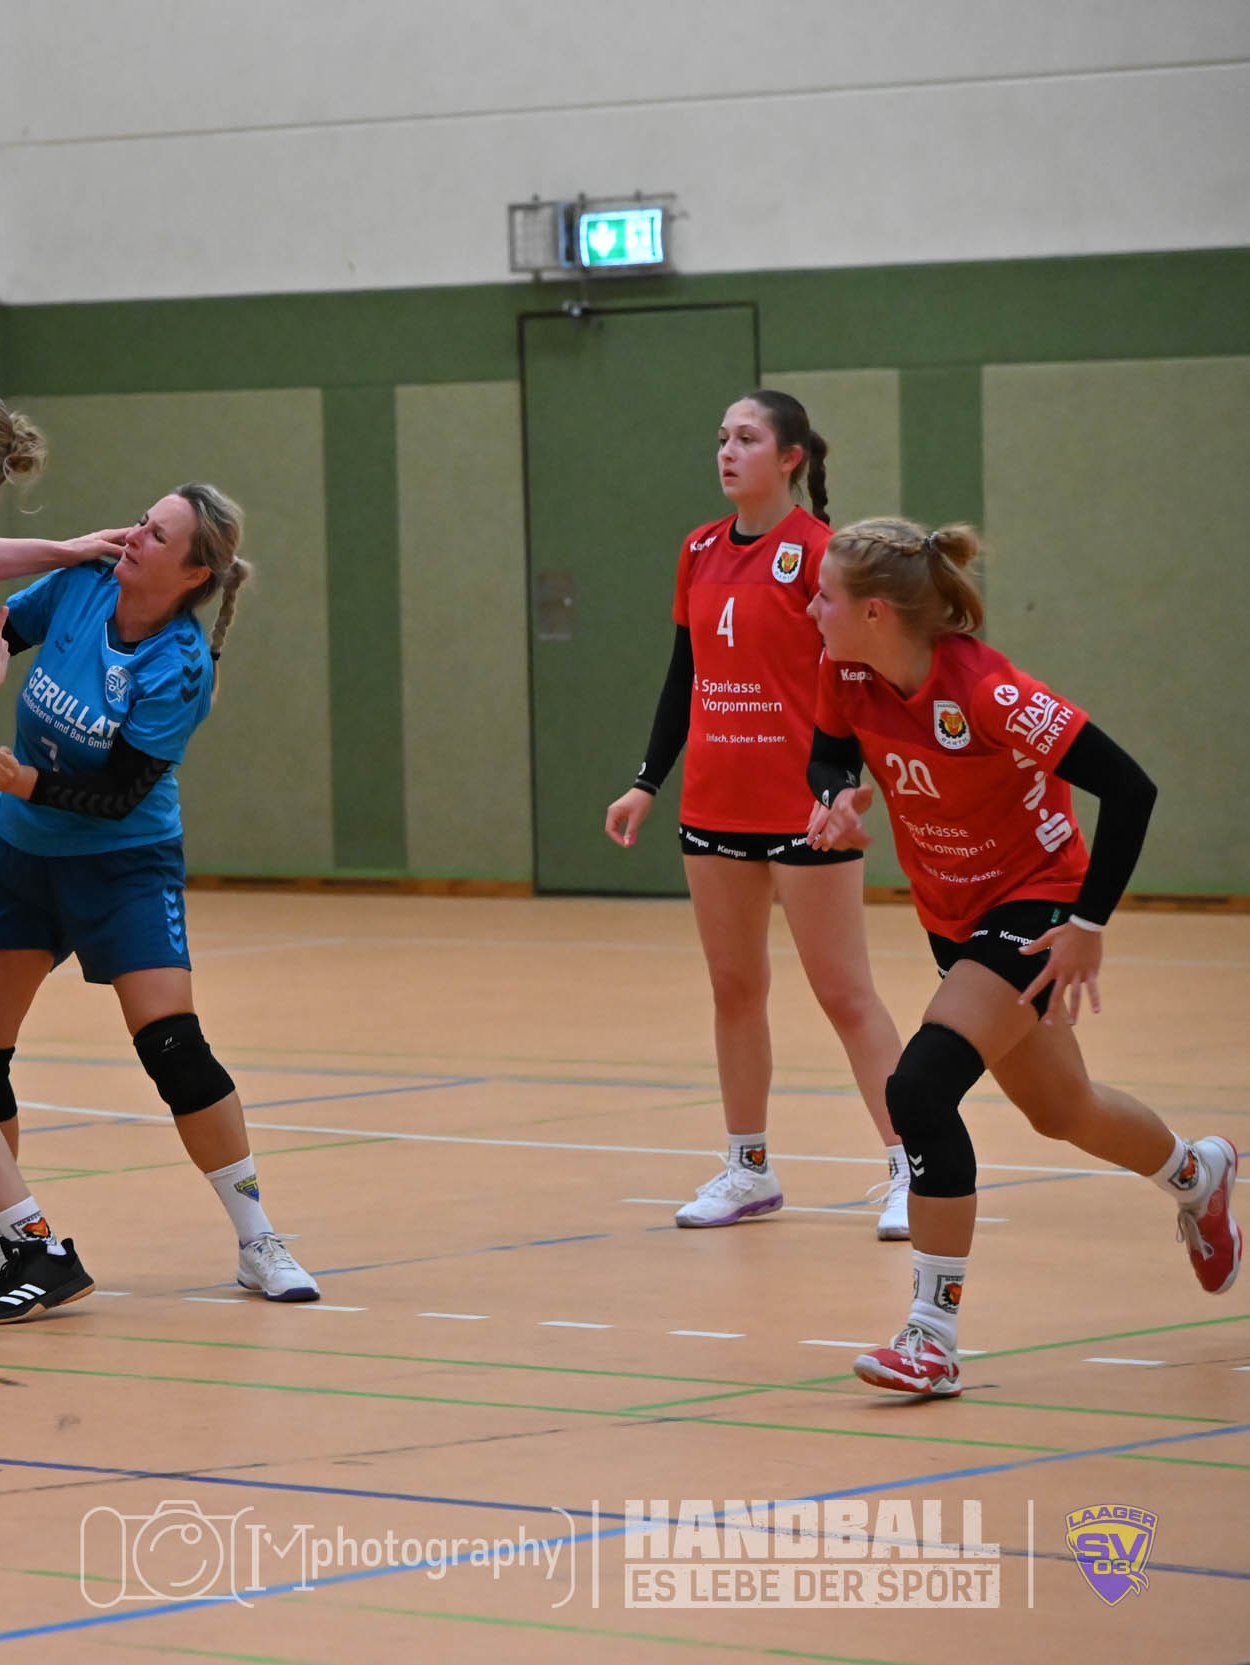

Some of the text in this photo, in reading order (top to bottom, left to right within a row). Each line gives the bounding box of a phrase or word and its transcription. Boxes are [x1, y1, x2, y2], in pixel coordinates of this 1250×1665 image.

[716, 597, 735, 648] 4
[28, 666, 121, 738] GERULLAT
[701, 679, 762, 695] Sparkasse
[701, 697, 783, 715] Vorpommern
[54, 717, 71, 735] und
[70, 728, 87, 744] Bau
[87, 737, 113, 750] GmbH
[1035, 706, 1073, 755] BARTH
[885, 752, 941, 799] 20
[686, 832, 710, 848] Kempa
[717, 844, 747, 858] Kempa
